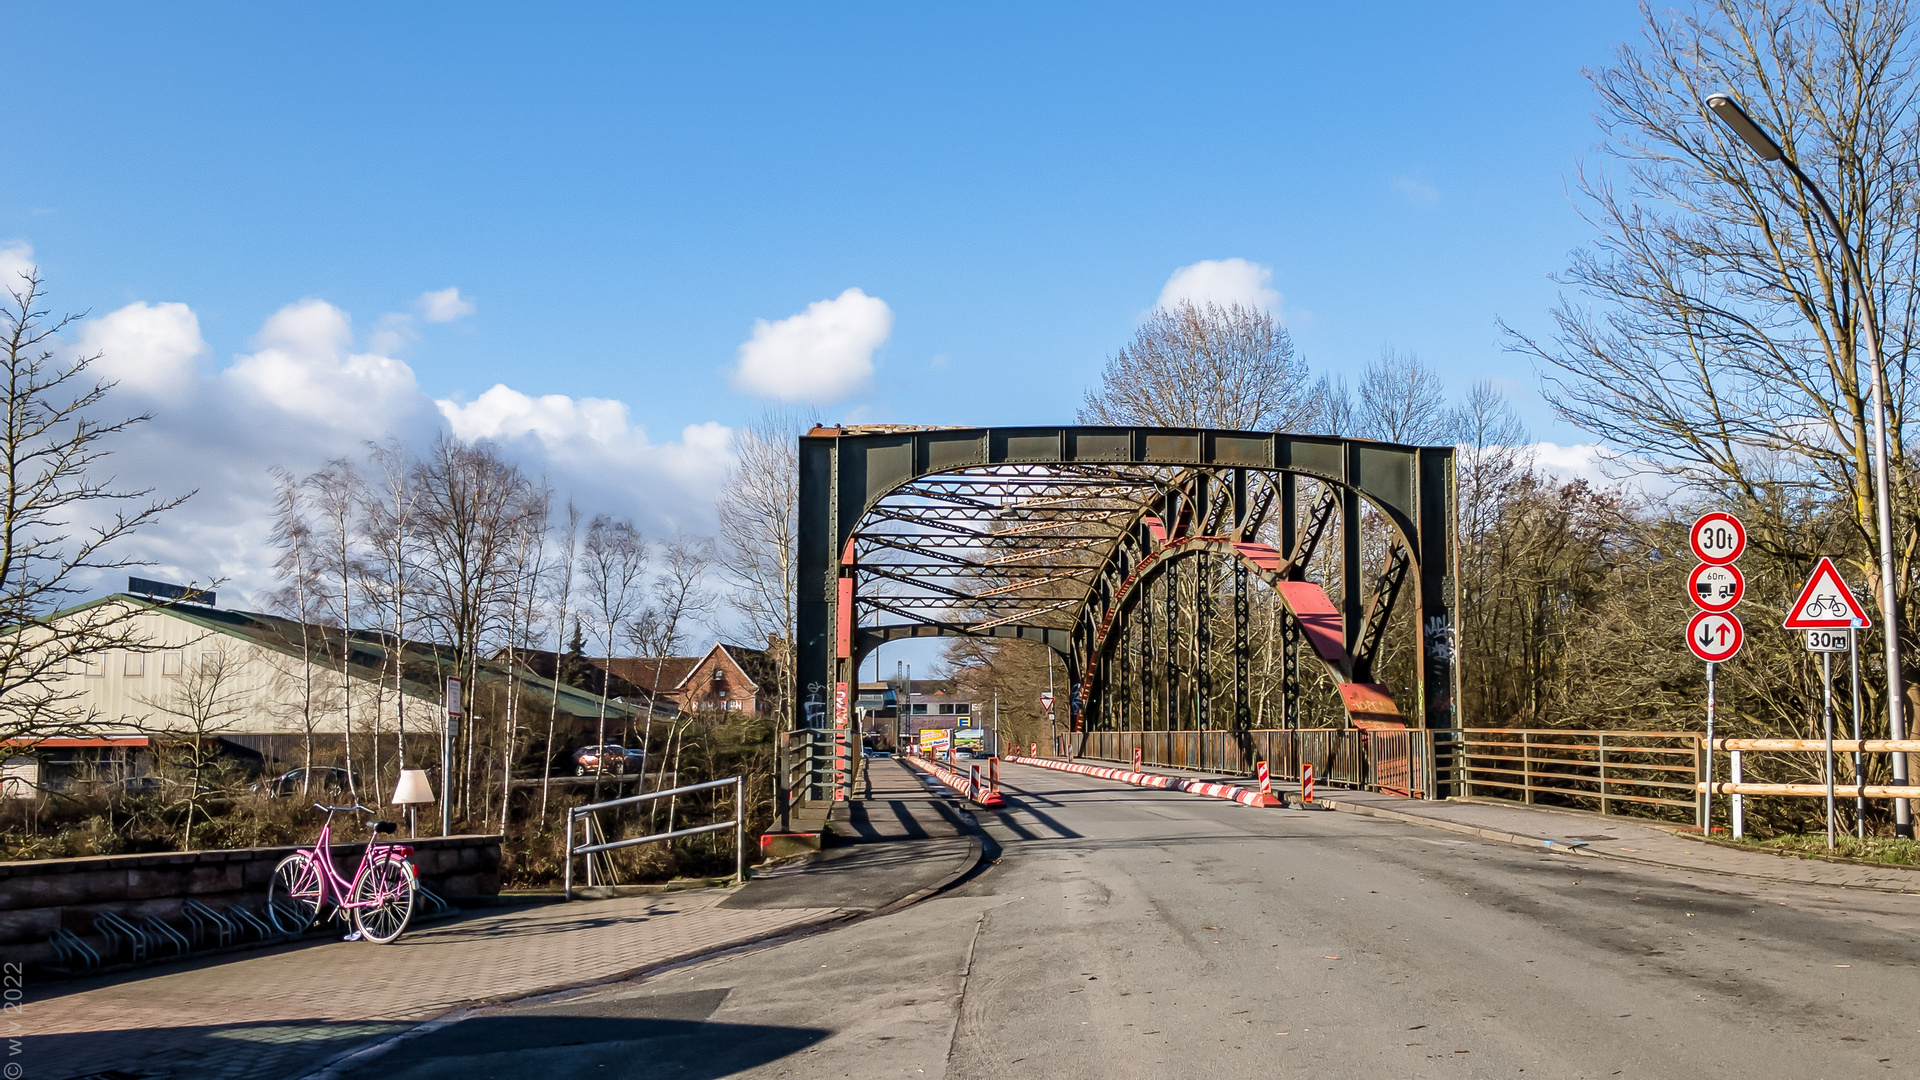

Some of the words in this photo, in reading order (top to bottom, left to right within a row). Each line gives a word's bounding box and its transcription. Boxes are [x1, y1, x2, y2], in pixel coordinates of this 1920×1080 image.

[1704, 528, 1733, 549] 30t
[1810, 632, 1846, 647] 30m
[959, 718, 969, 727] E
